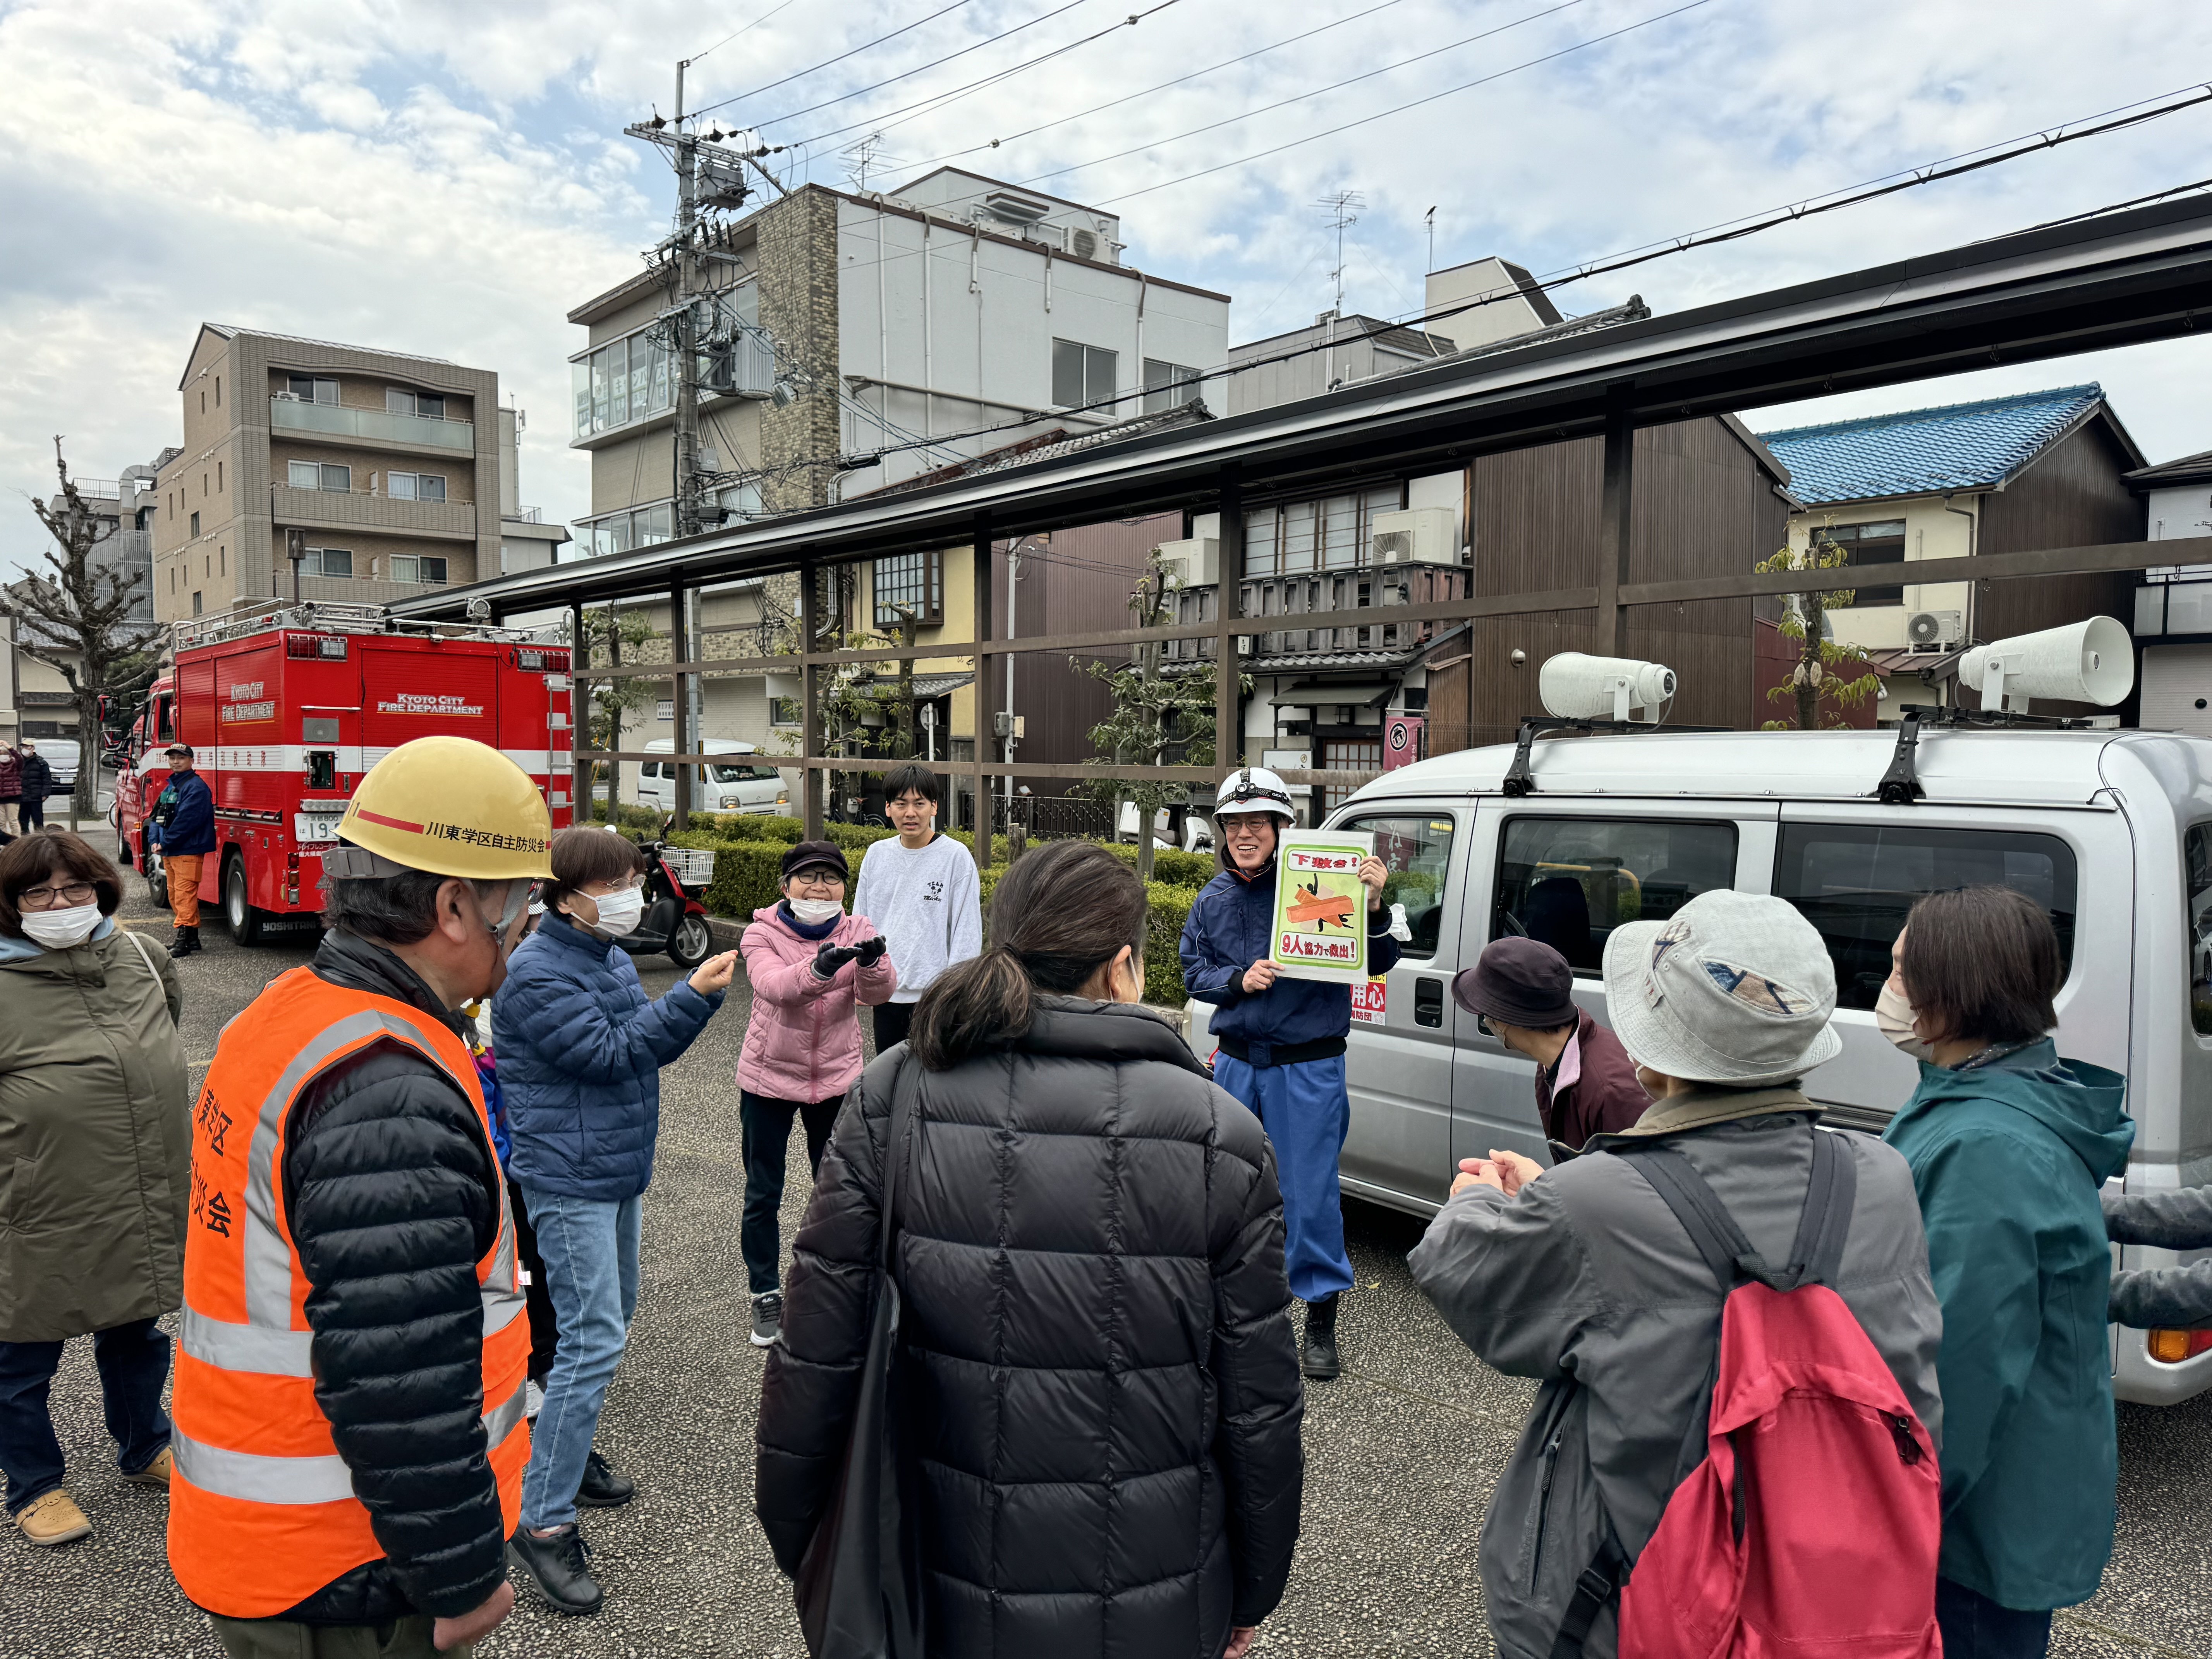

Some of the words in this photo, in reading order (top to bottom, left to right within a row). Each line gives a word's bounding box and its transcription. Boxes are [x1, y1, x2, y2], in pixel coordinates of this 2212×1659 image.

[426, 821, 545, 852] 川東学区自主防災会
[263, 922, 316, 931] YOSHITANI
